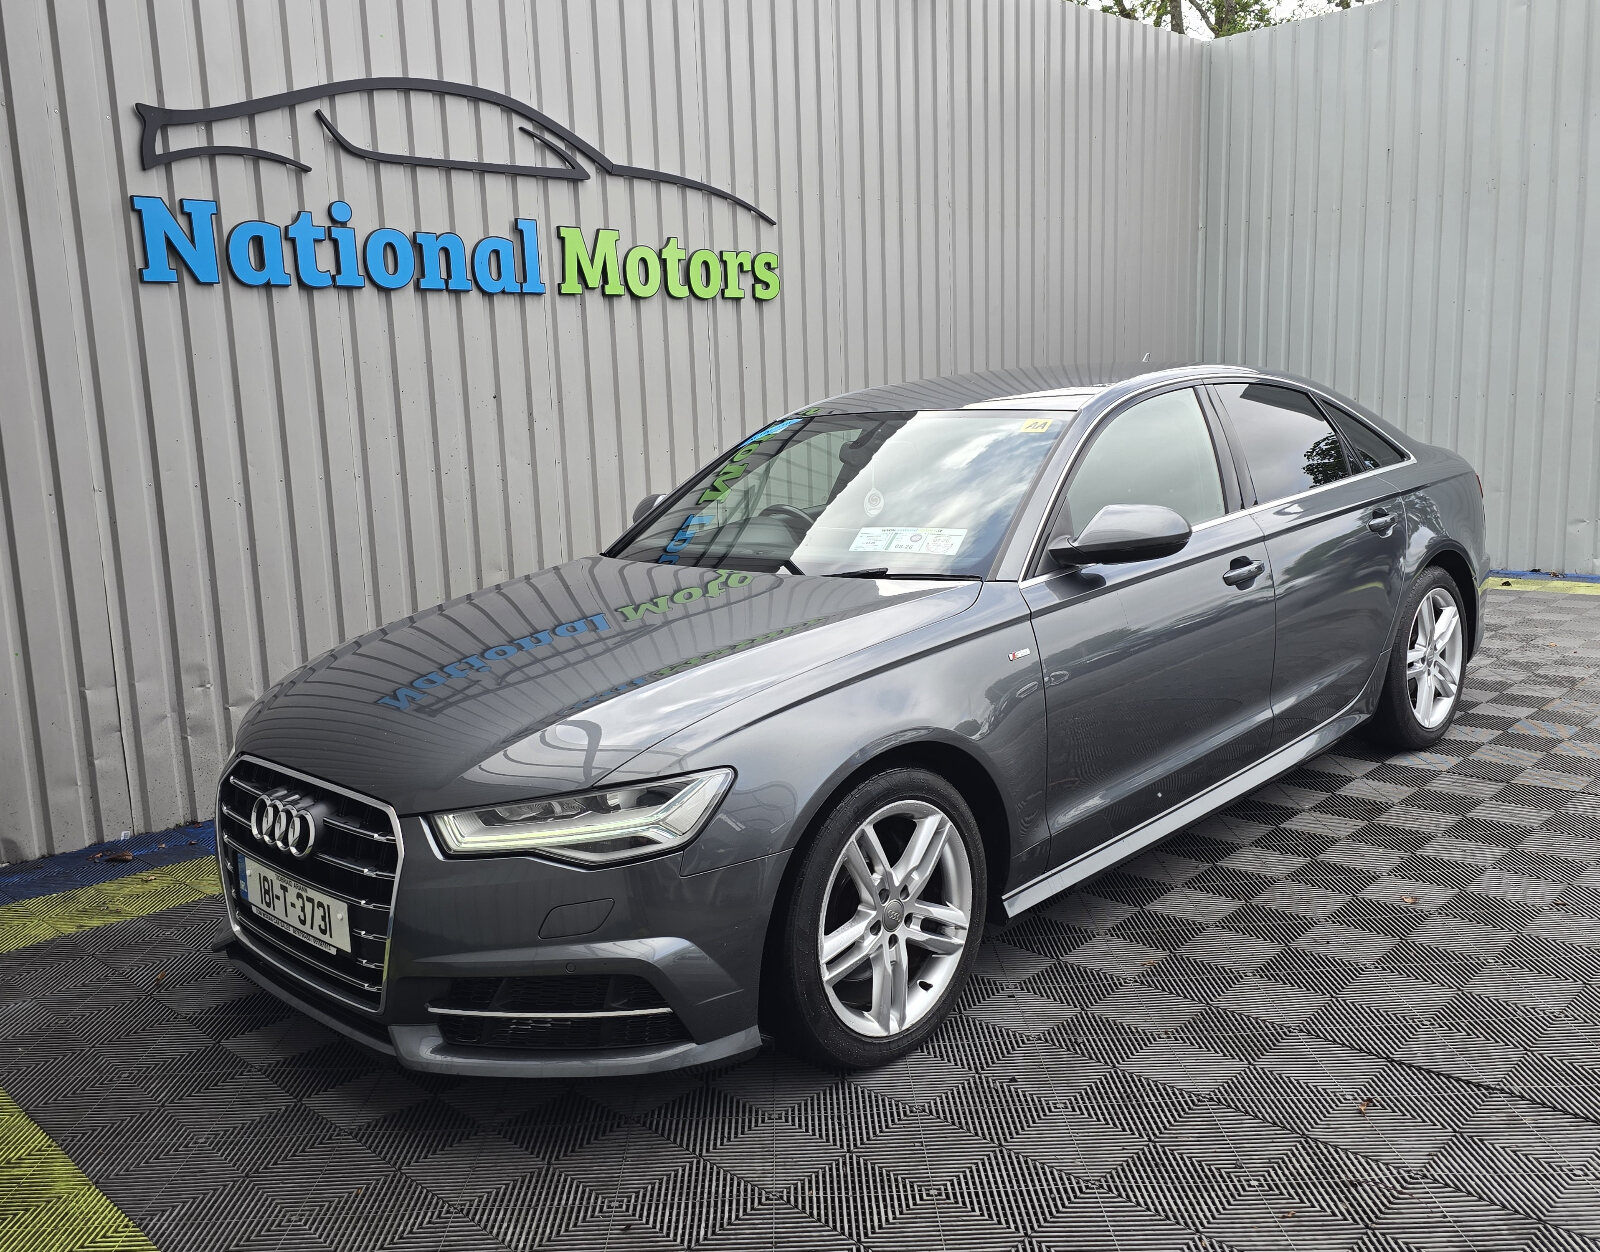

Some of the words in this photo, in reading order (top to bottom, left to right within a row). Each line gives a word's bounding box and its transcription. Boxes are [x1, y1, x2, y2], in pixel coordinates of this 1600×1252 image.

[131, 195, 546, 295] National
[557, 225, 781, 300] Motors
[1025, 421, 1048, 430] AA
[258, 872, 333, 939] 181-T-3731
